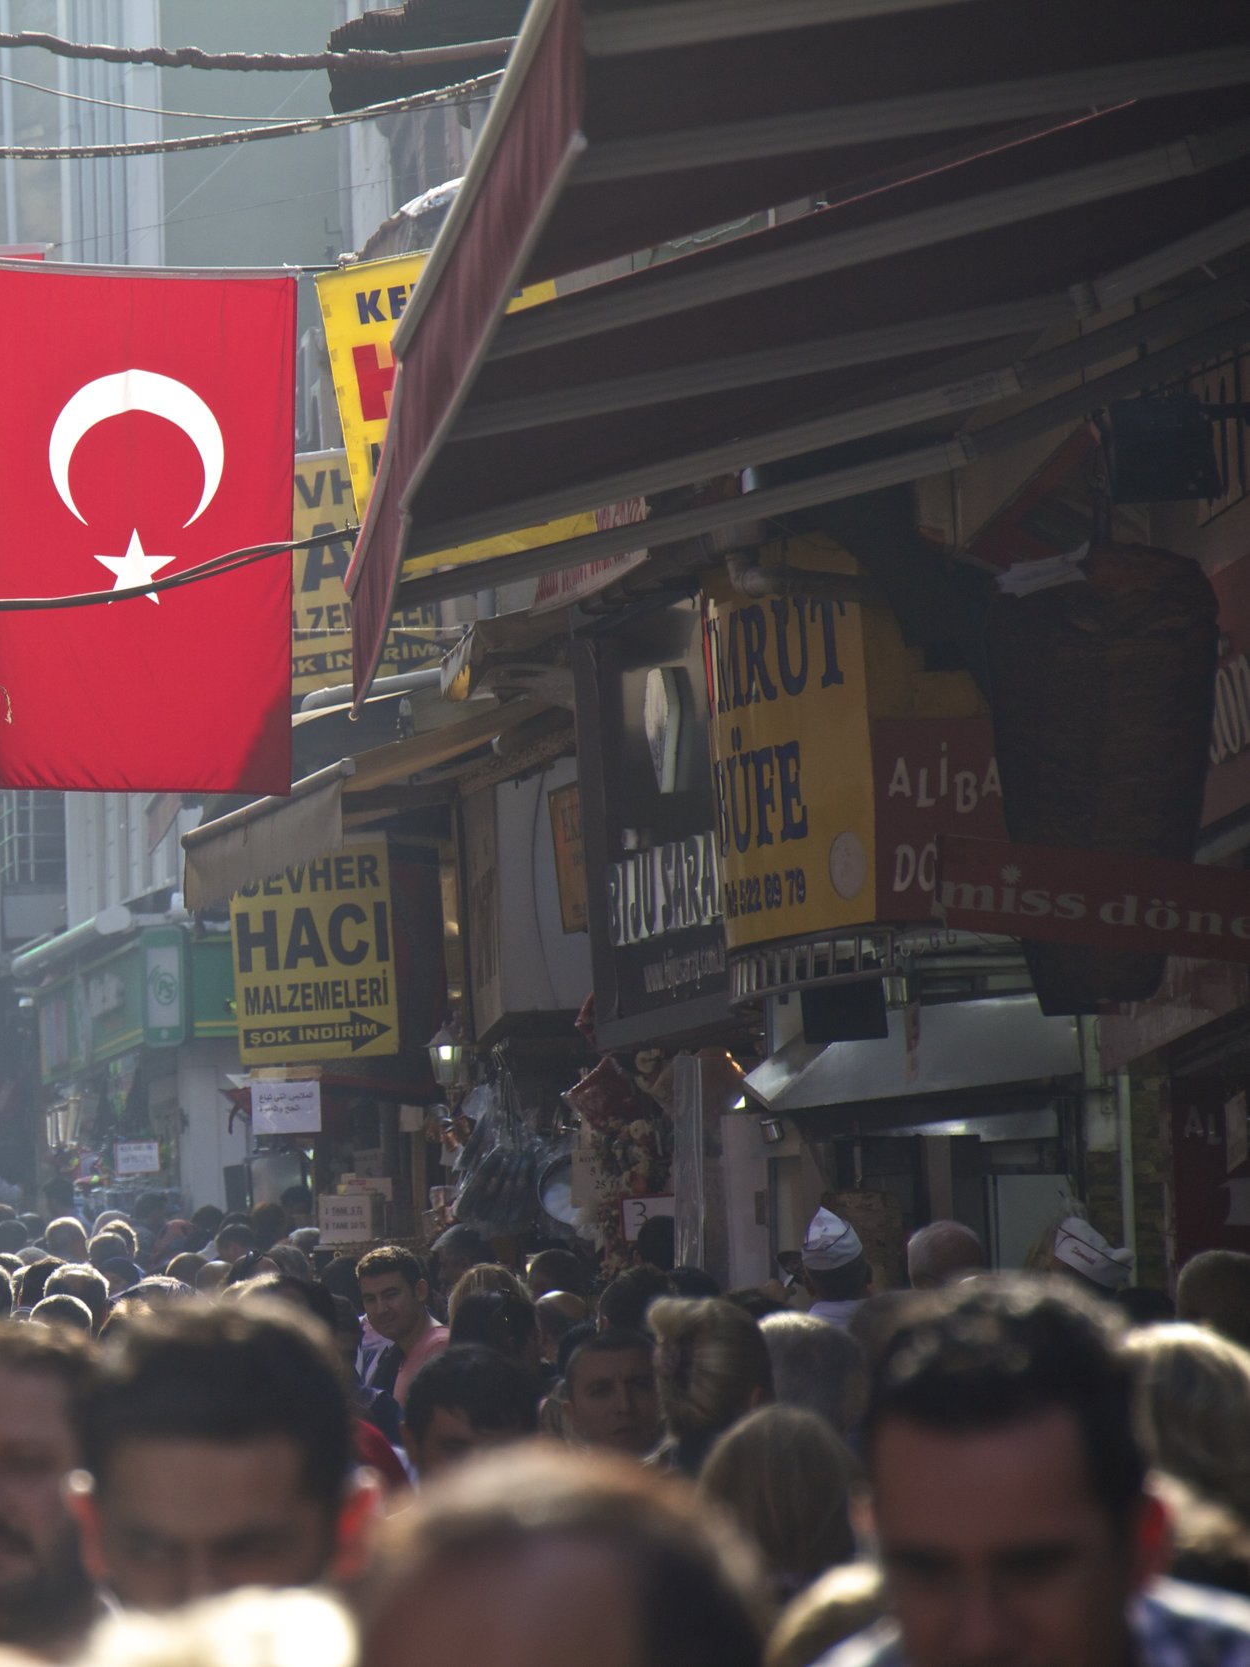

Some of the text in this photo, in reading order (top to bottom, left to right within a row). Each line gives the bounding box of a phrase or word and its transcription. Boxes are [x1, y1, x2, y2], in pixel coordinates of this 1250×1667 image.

[356, 283, 417, 325] KE
[941, 865, 1087, 920] miss
[236, 902, 390, 973] HACI
[244, 969, 389, 1016] MALZEMELERİ
[251, 1021, 378, 1047] ŞOK İNDİRİM
